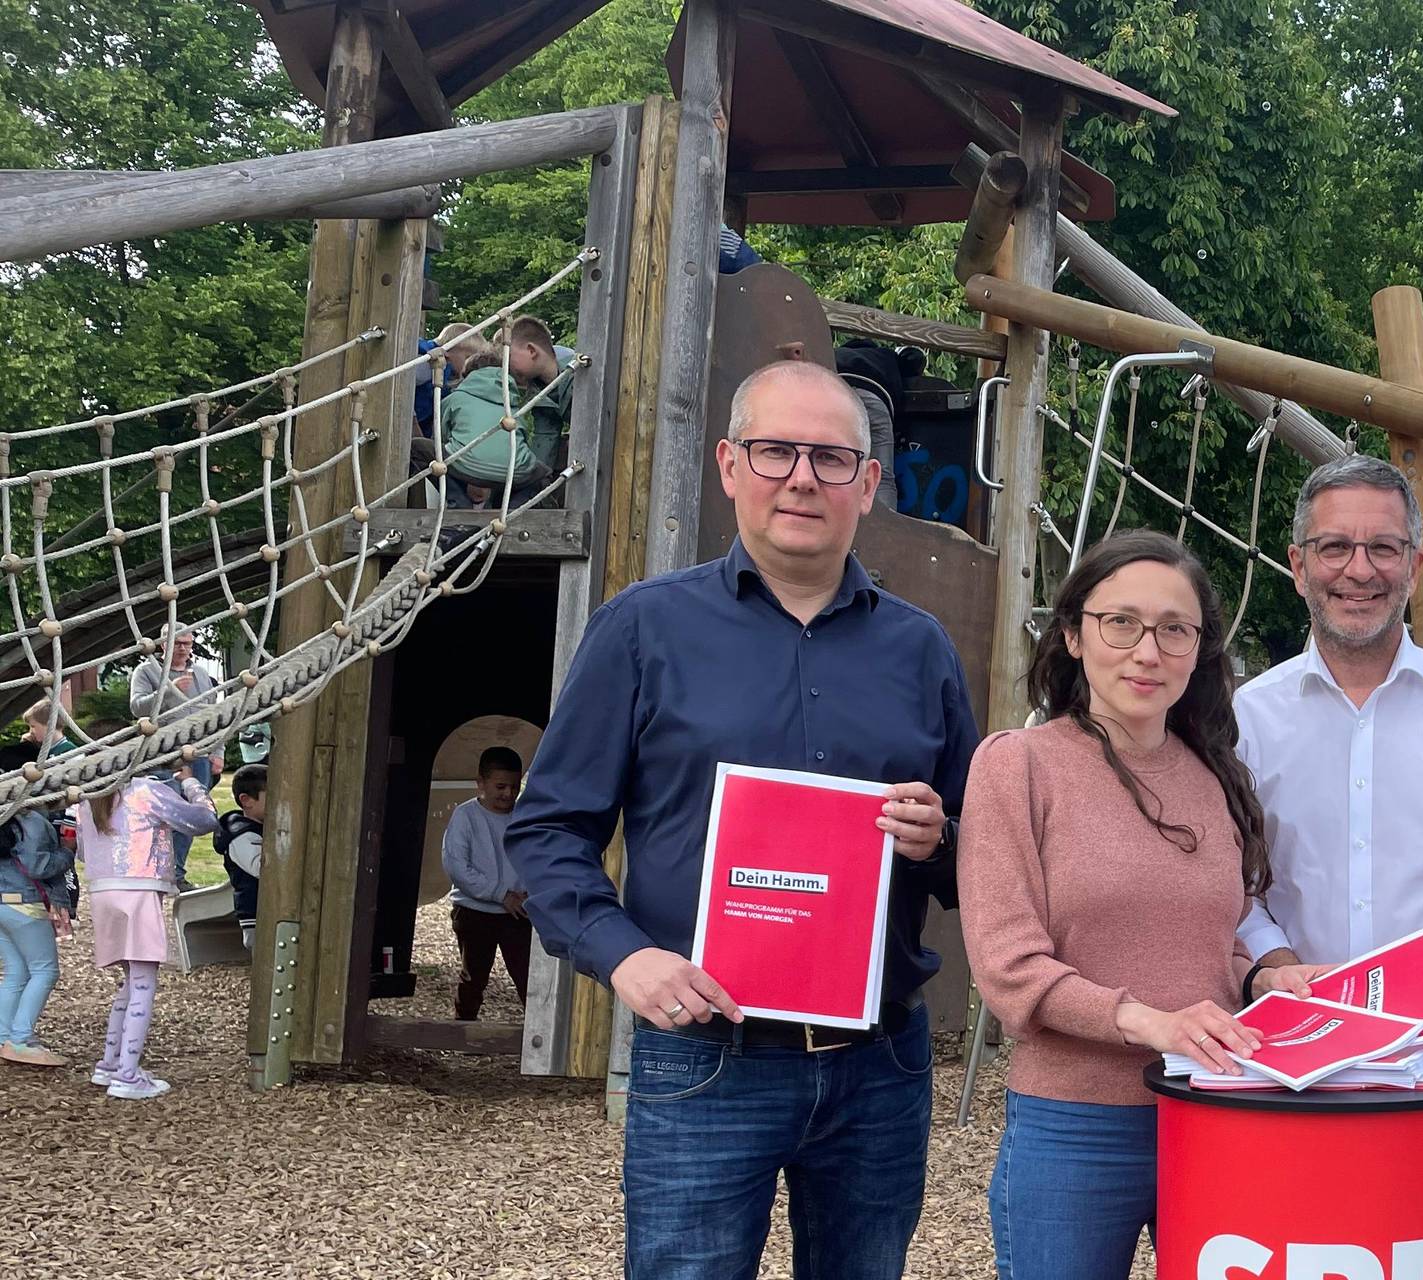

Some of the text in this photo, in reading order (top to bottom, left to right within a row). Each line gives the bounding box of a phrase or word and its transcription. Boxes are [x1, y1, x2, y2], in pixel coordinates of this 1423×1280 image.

[735, 871, 824, 890] Dein Hamm.
[724, 909, 748, 918] HAMM
[747, 912, 763, 920] VON
[725, 900, 812, 918] WAHLPROGRAMM FÜR DAS
[1371, 970, 1381, 993] Dein
[656, 1062, 689, 1072] LEGEND
